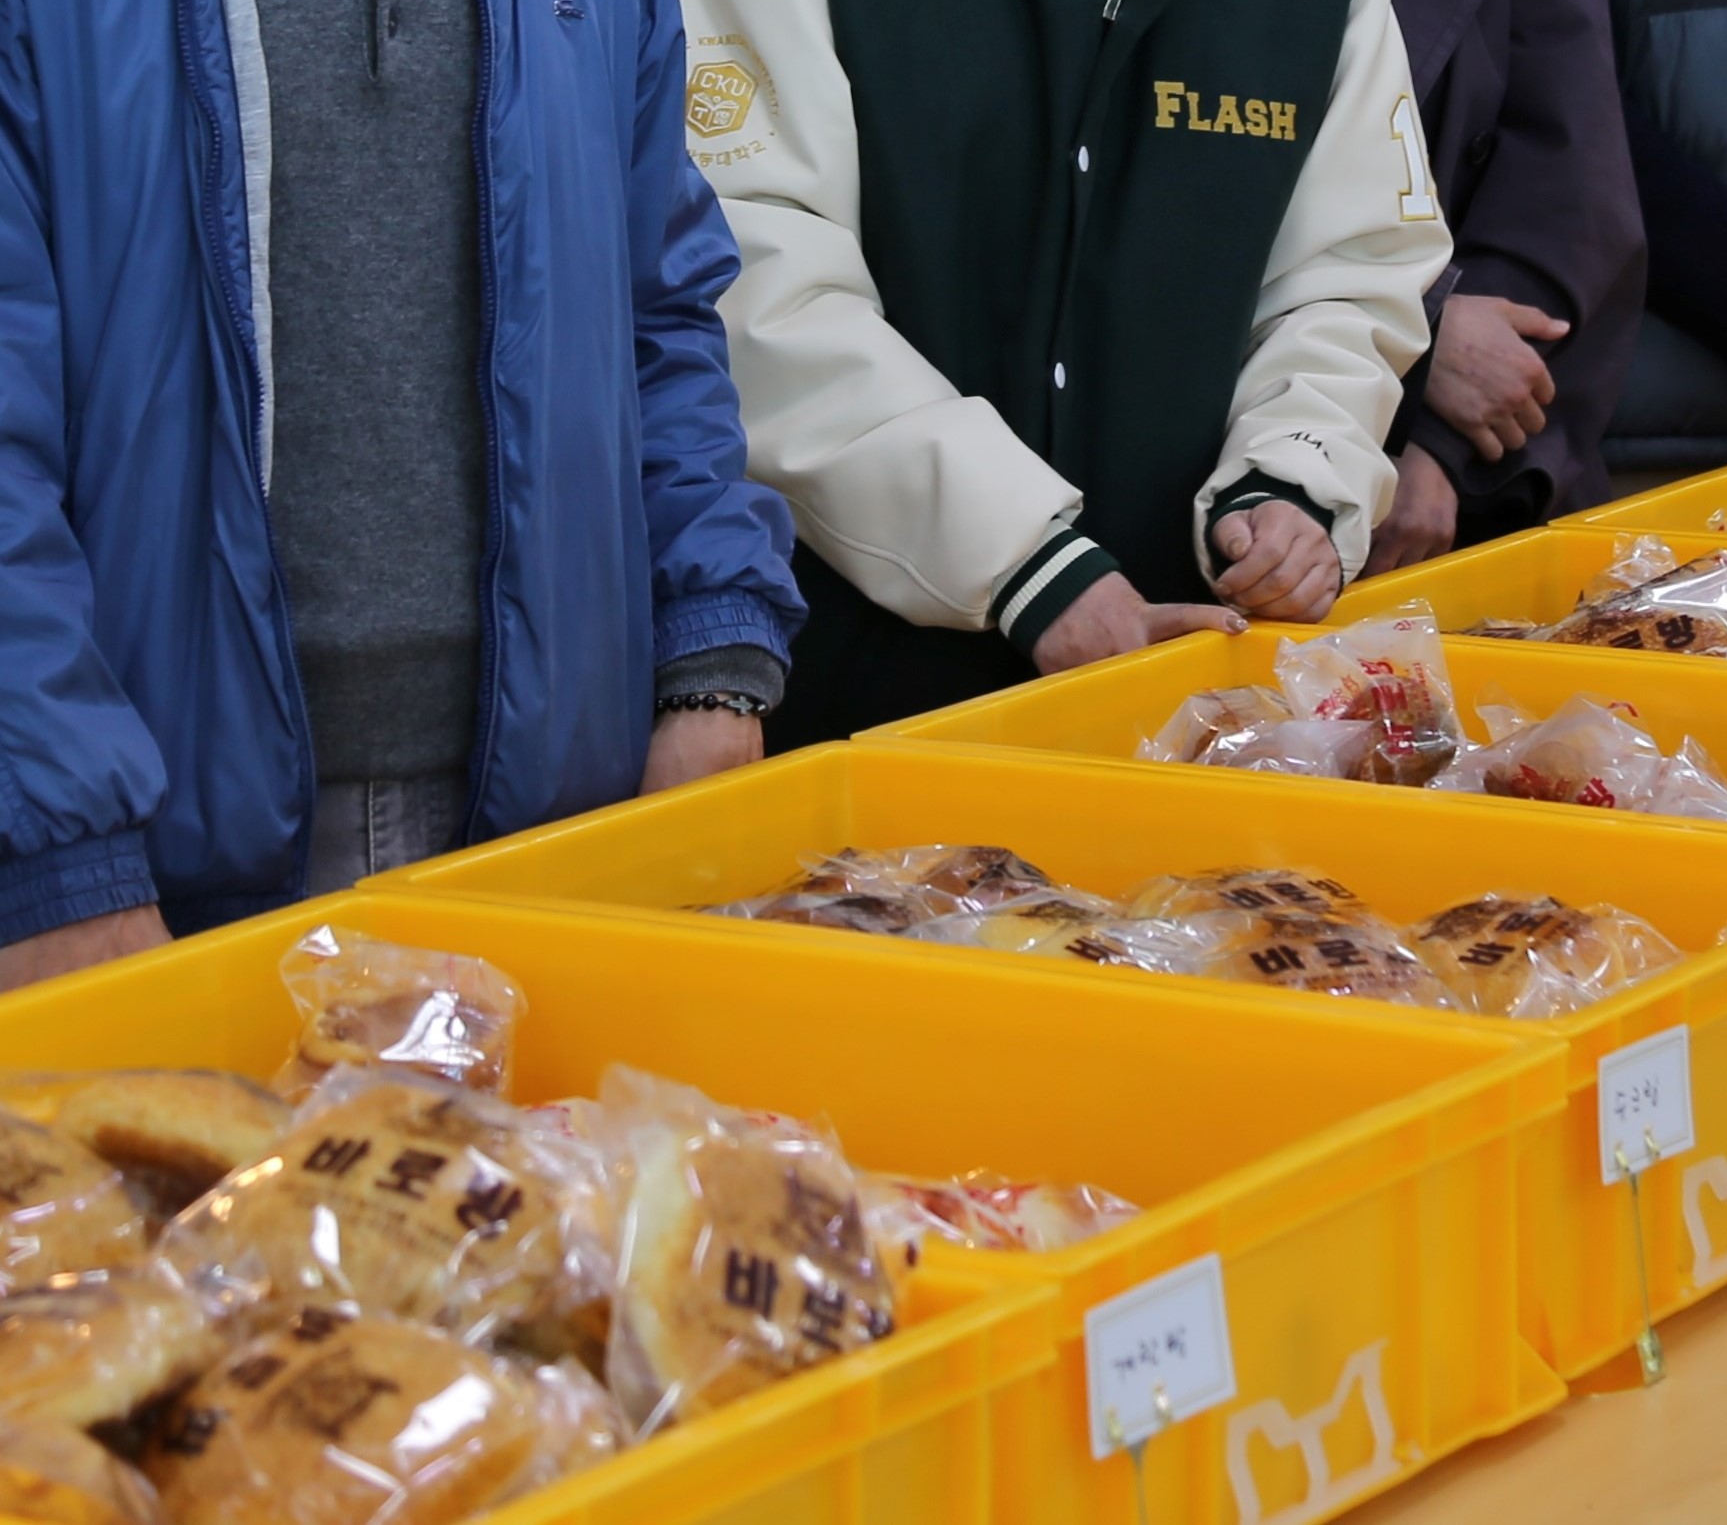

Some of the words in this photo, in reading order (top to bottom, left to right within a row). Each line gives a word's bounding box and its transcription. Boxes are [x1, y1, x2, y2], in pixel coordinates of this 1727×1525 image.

[700, 71, 748, 97] CKU
[1154, 80, 1297, 142] FLASH
[1390, 91, 1438, 223] 1
